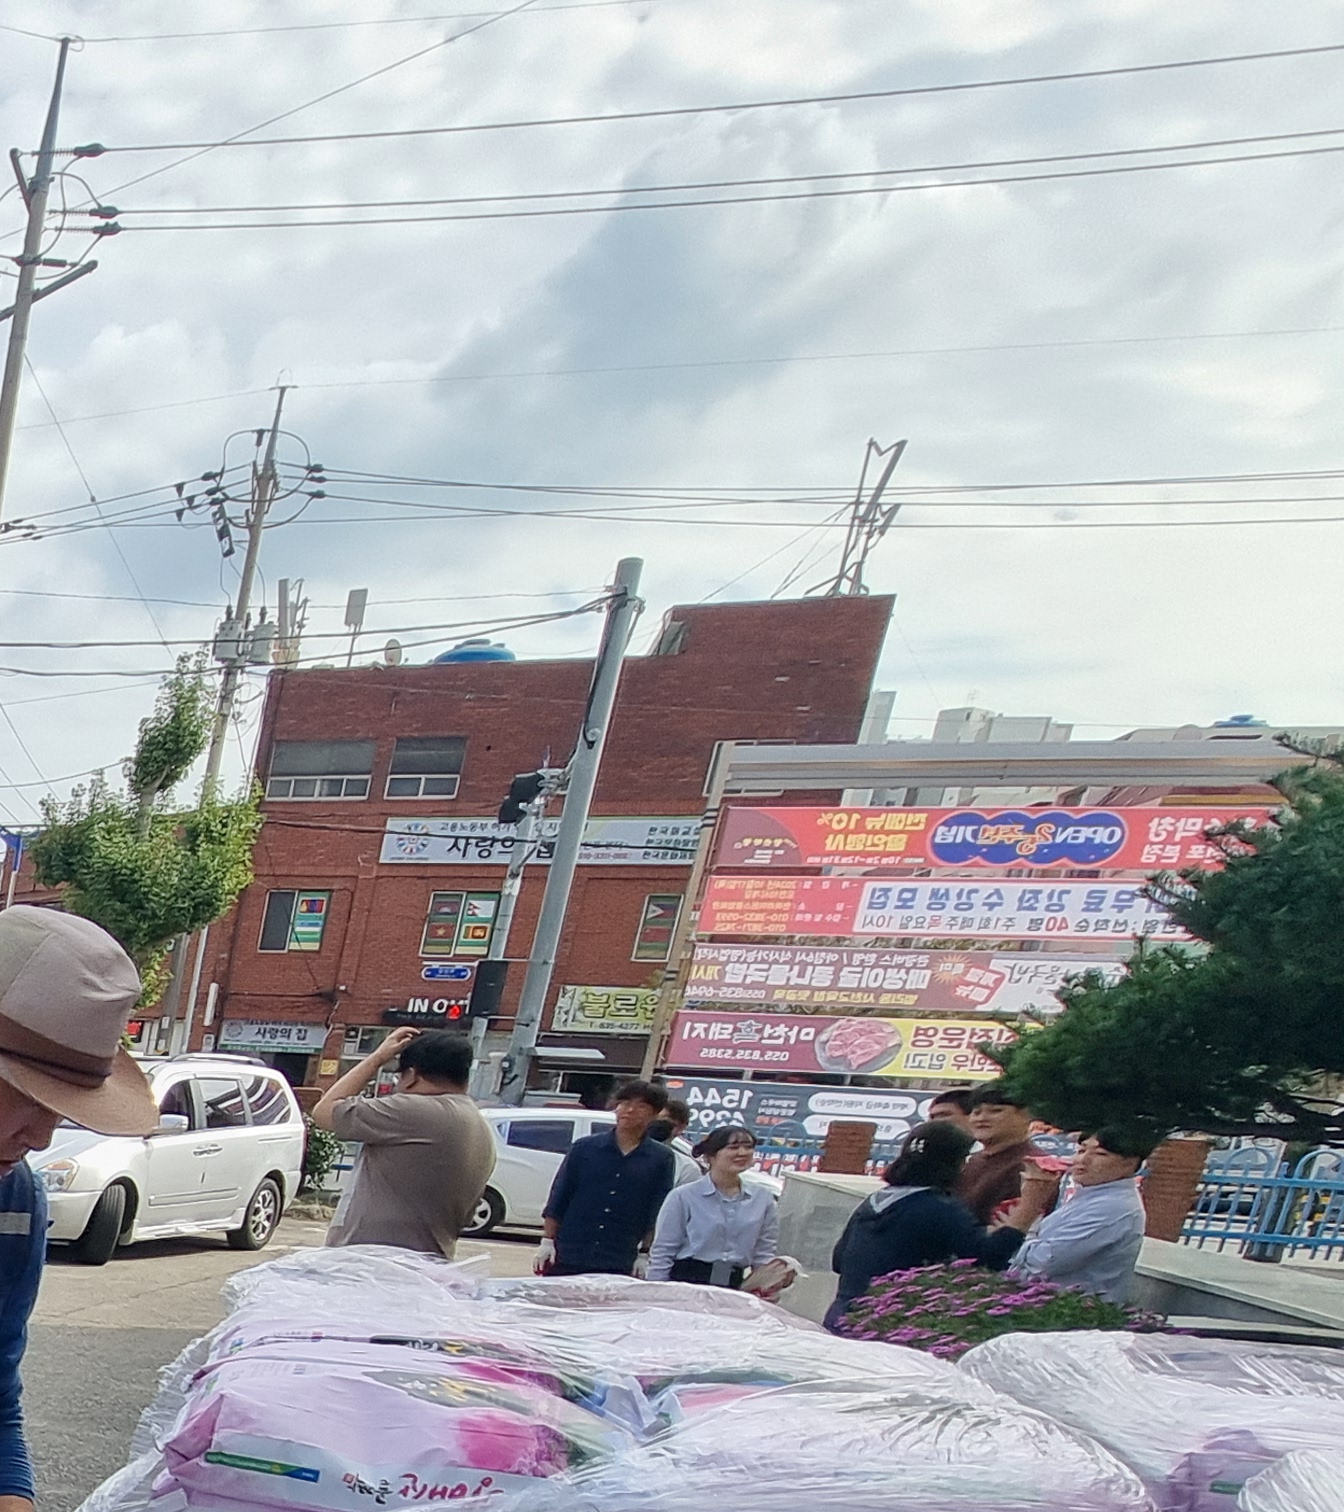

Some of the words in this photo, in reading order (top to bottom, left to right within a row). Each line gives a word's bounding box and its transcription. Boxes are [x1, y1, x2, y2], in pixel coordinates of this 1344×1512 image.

[407, 997, 429, 1013] IN
[255, 1026, 292, 1041] 사랑의
[295, 1028, 309, 1041] 집
